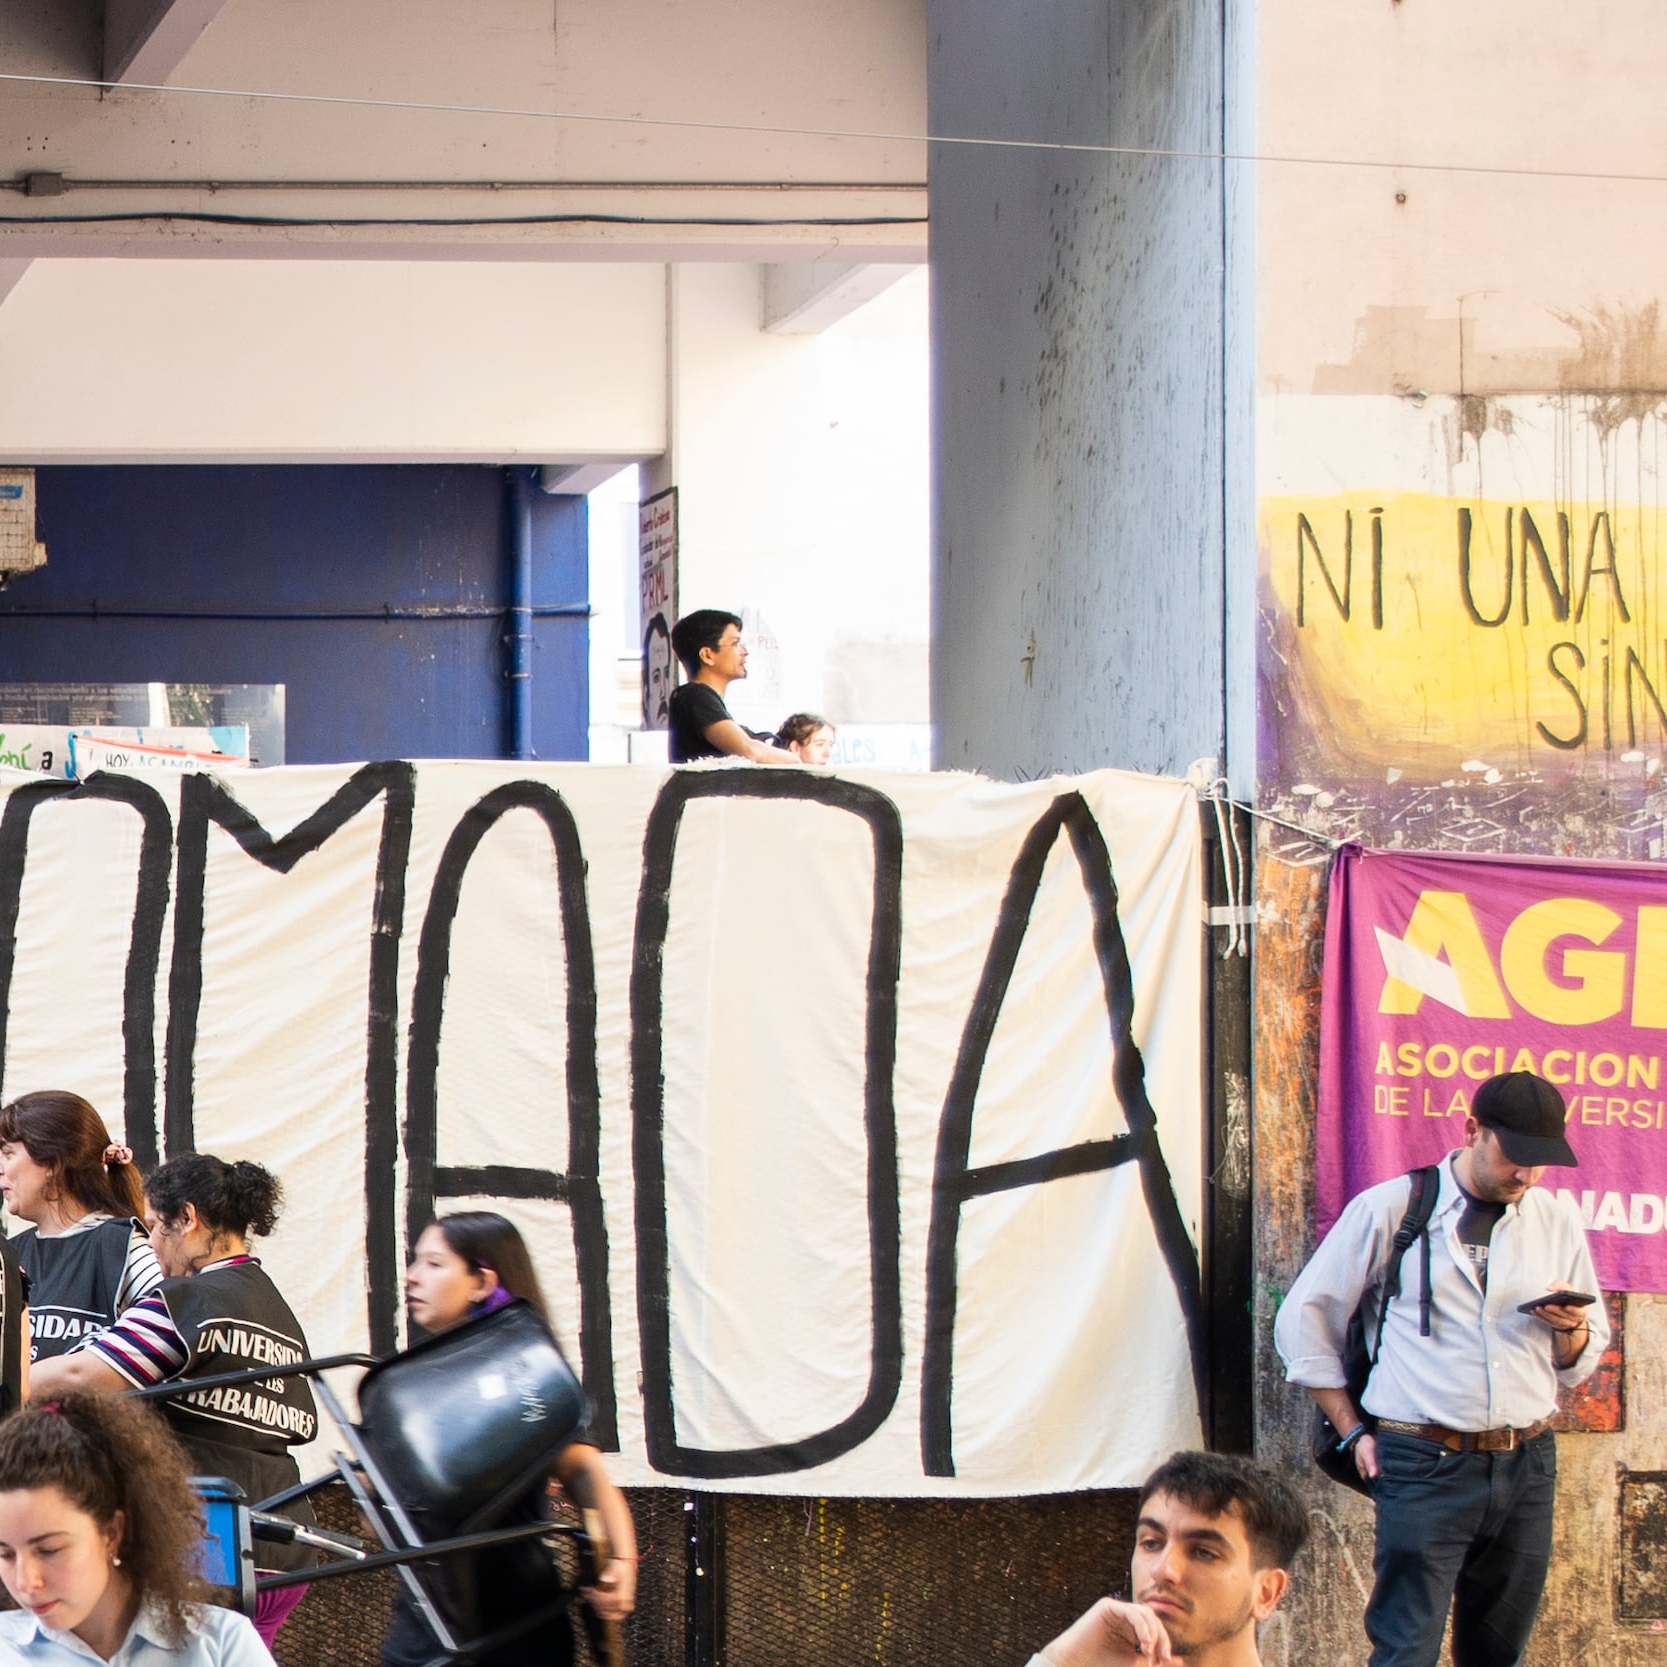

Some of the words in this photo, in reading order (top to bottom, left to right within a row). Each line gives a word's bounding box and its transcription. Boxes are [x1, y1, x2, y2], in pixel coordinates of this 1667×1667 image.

[1457, 506, 1631, 627] UNA
[1375, 1040, 1659, 1090] ASOCIACION
[1374, 1085, 1409, 1117] DE
[1423, 1088, 1470, 1118] LA
[176, 1384, 315, 1439] RABAJADORES
